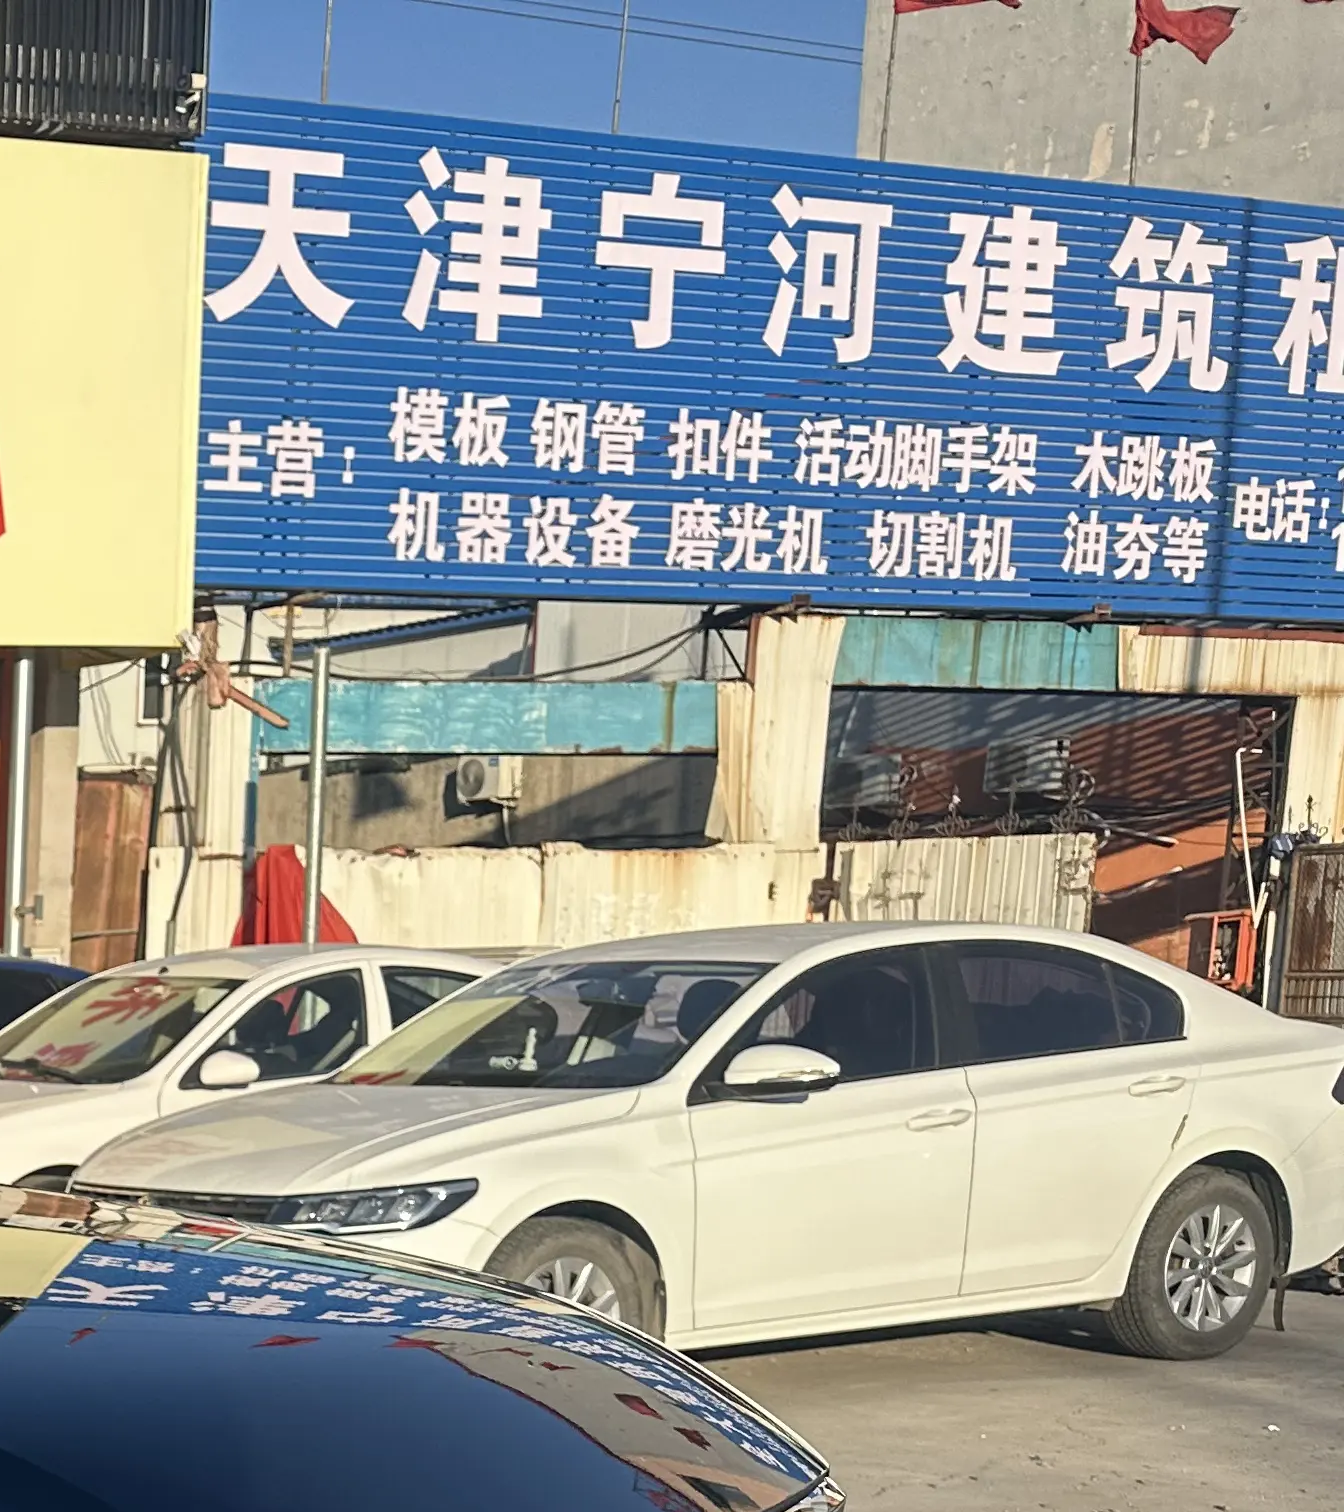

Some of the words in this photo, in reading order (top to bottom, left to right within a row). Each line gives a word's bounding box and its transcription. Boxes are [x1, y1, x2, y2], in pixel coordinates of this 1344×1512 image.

[388, 386, 509, 467] 模板
[530, 398, 646, 476] 钢管
[668, 408, 772, 483] 扣件
[794, 418, 1037, 496] 活动脚手架
[1070, 430, 1216, 504] 木跳板
[387, 487, 640, 569] 机器设备
[664, 497, 828, 575] 磨光机
[866, 509, 1016, 582] 切割机
[1061, 510, 1209, 584] 油夯等
